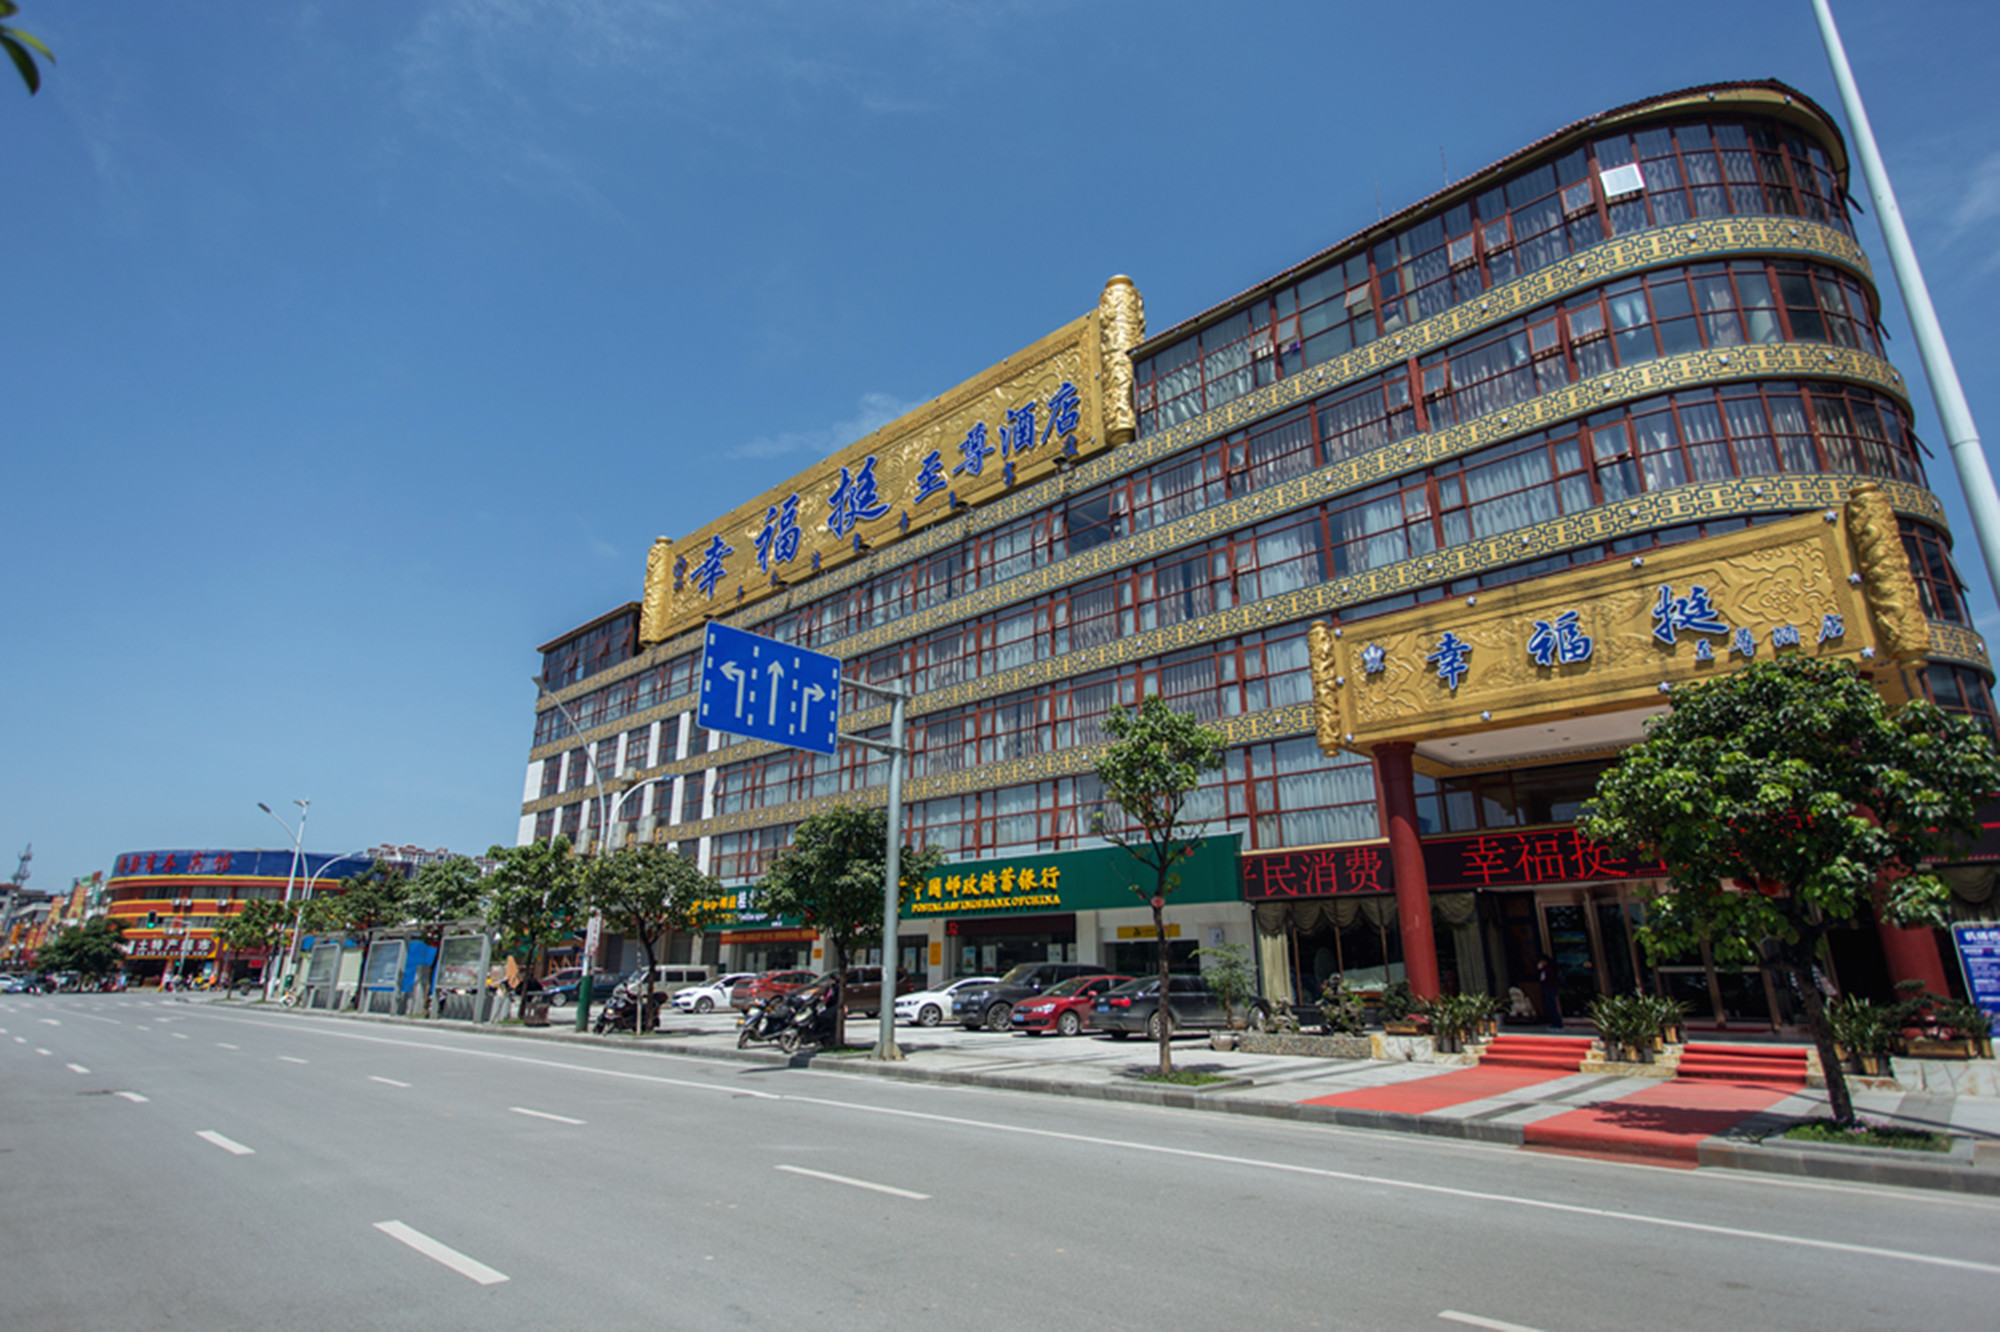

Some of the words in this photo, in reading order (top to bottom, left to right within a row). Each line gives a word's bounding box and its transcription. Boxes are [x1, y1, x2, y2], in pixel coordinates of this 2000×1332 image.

[1425, 584, 1730, 690] 幸福挺
[1693, 613, 1846, 662] 至尊酒店
[119, 851, 233, 873] 商务宾馆
[1025, 894, 1061, 906] CHINA
